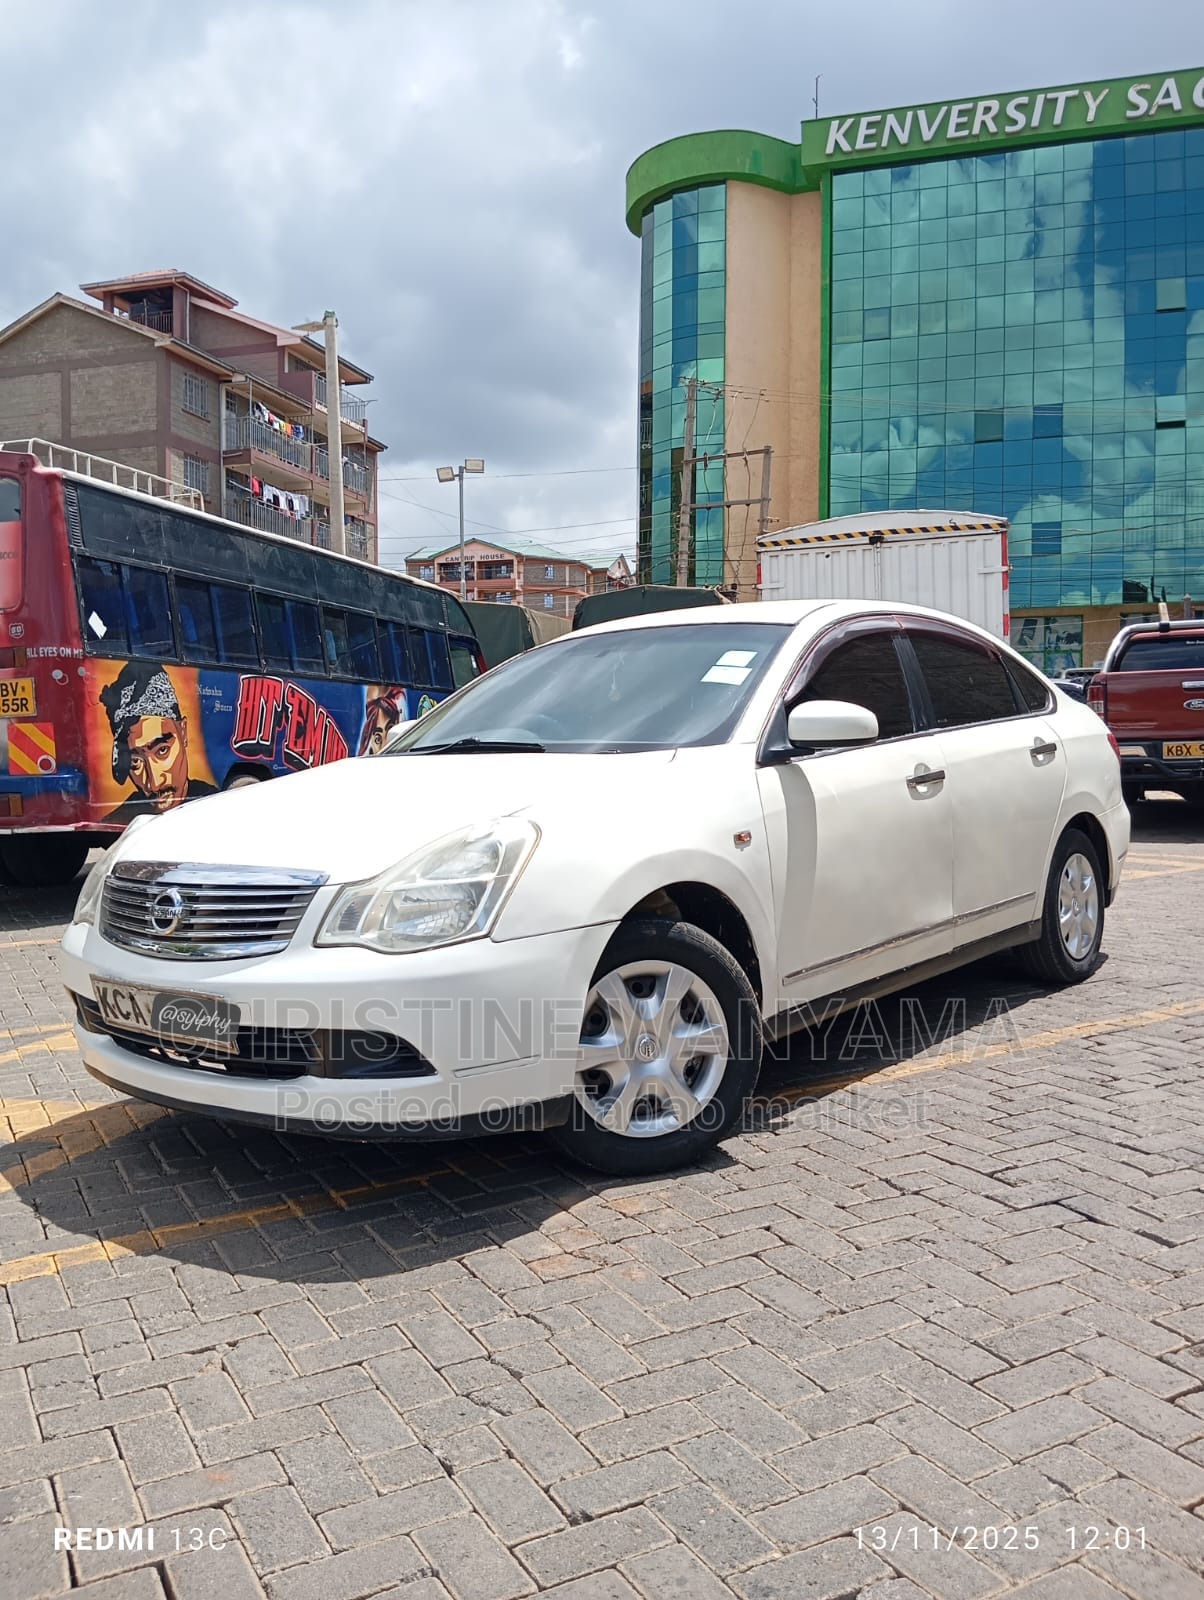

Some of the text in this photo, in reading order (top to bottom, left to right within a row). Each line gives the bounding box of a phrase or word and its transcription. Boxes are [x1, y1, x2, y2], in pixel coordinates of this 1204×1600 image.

[824, 88, 1109, 155] KENVERSITY
[27, 647, 83, 659] ALL EYES ON ME
[233, 675, 284, 748] HIT
[1166, 744, 1192, 756] KBX
[96, 986, 148, 1026] KCA
